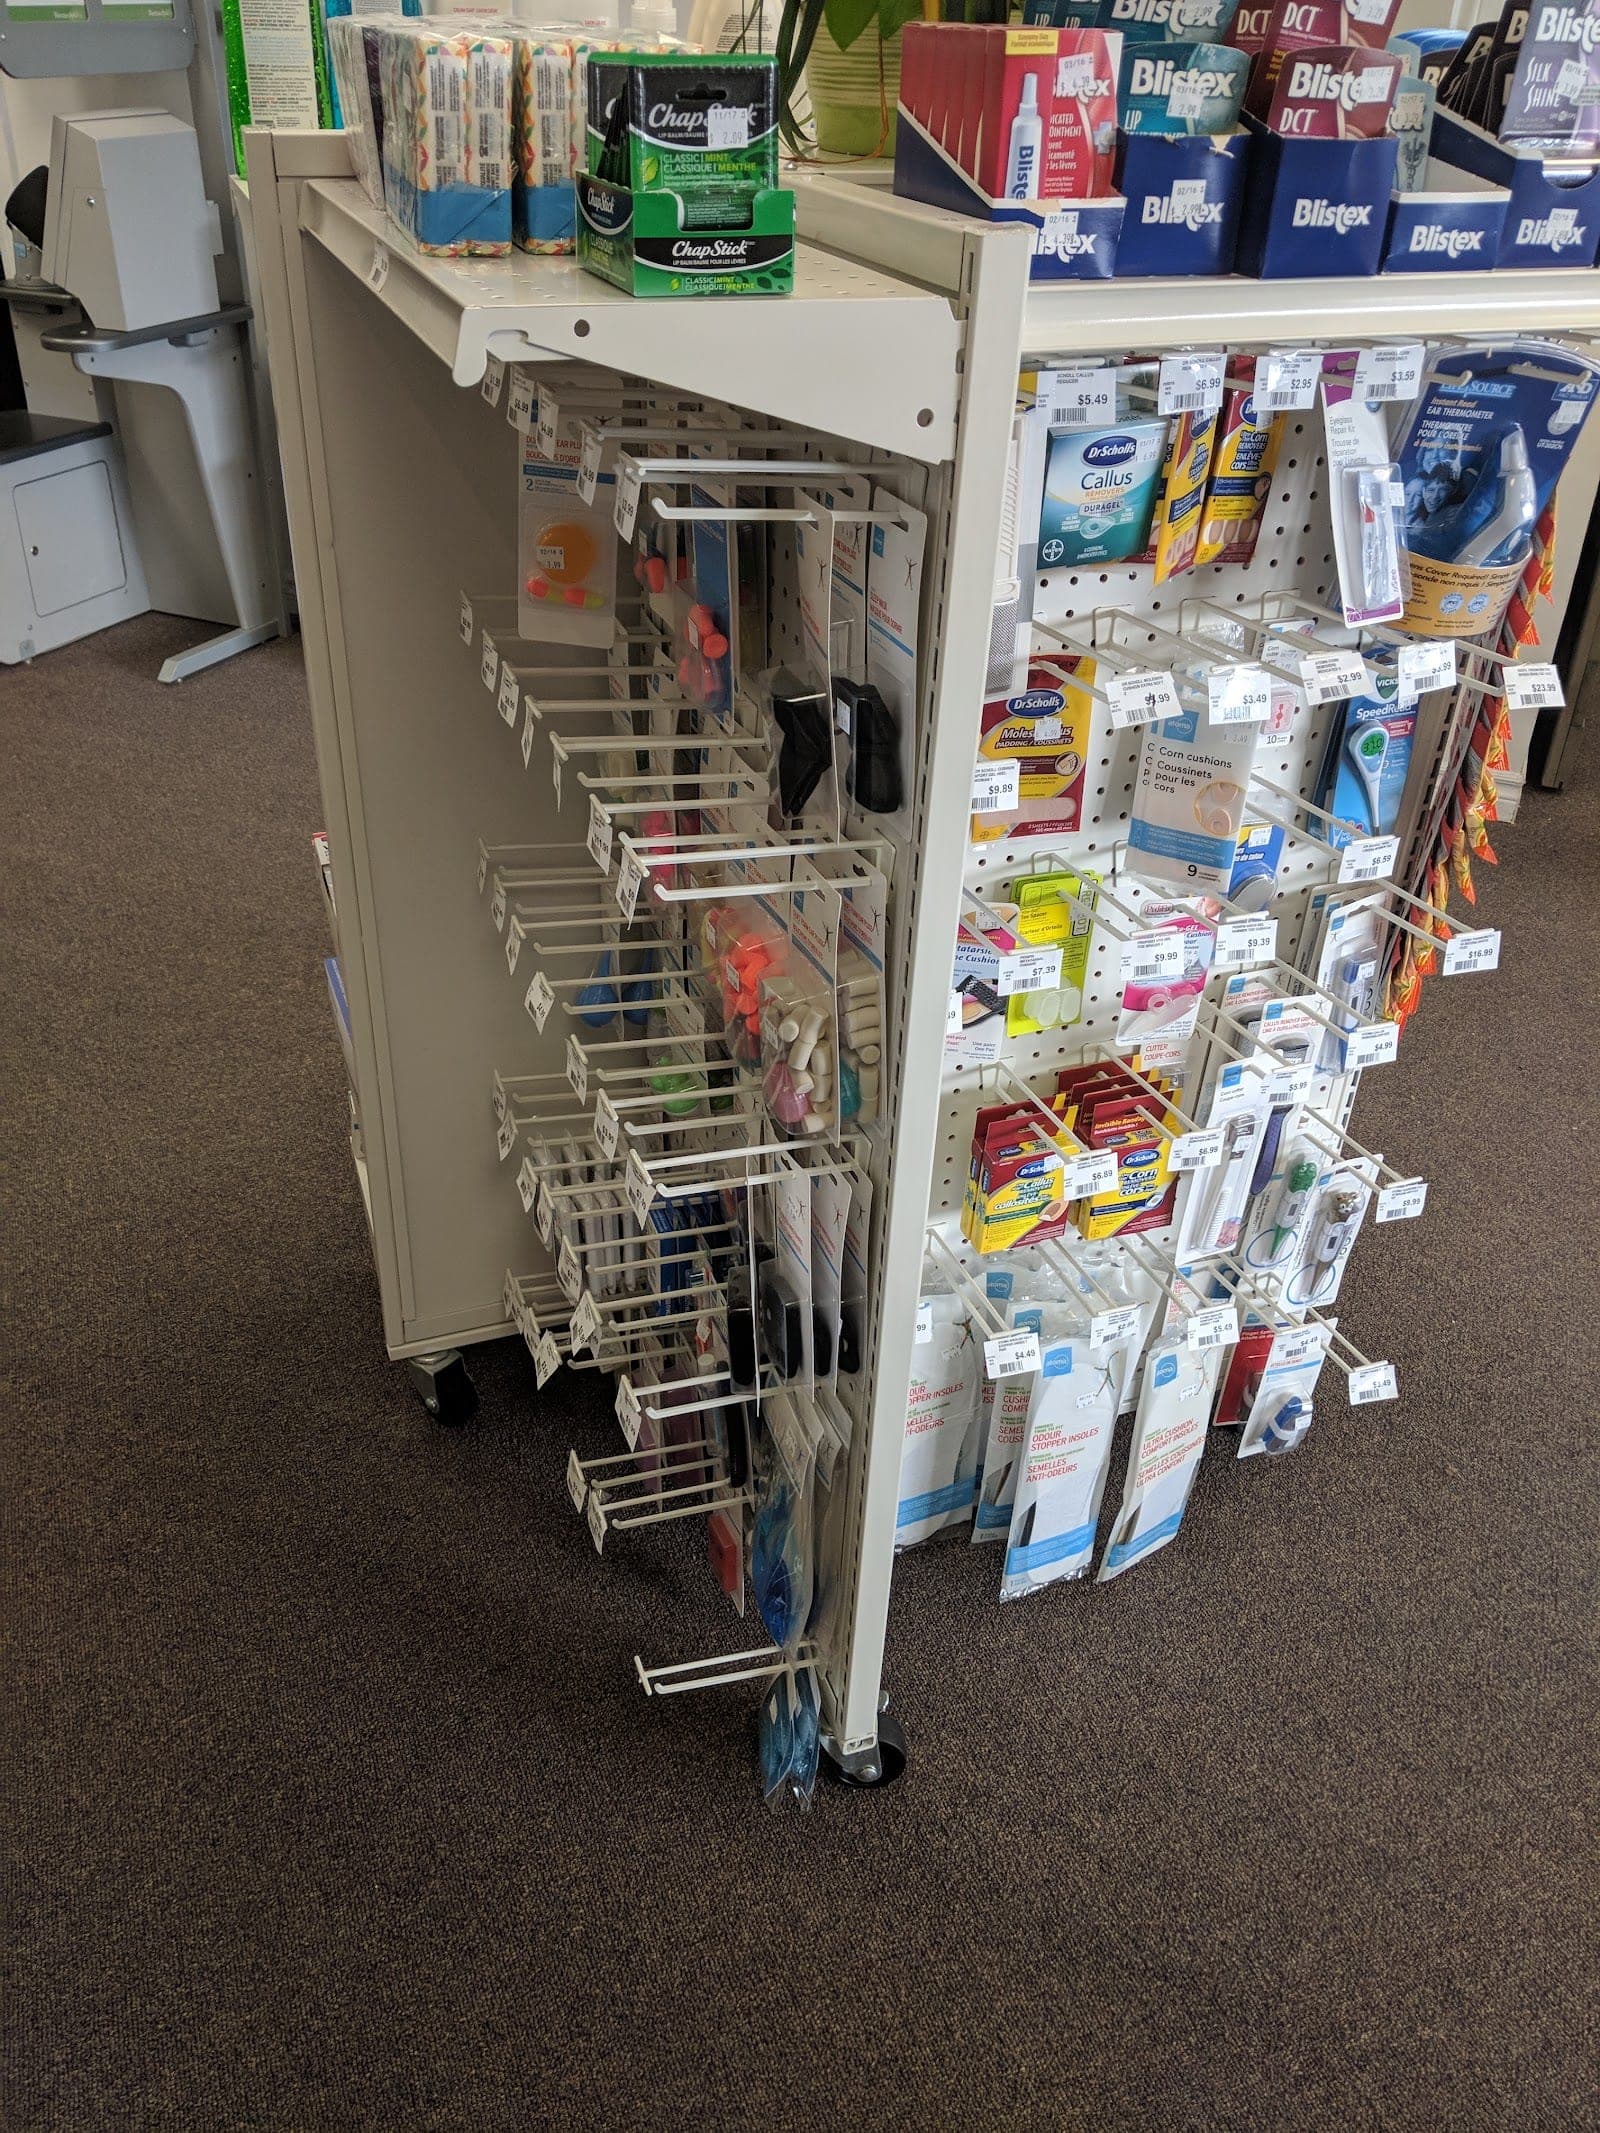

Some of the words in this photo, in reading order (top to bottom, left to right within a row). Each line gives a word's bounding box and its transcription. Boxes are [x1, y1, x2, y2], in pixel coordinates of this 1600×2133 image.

[1236, 9, 1272, 35] DCT
[1282, 2, 1321, 33] DCT
[1535, 7, 1600, 53] Bliste
[1288, 61, 1362, 111] Bliste
[649, 103, 758, 131] Chapk
[1124, 110, 1142, 130] LIP
[1279, 107, 1318, 133] DCT
[663, 153, 699, 163] CLASSIC
[705, 153, 729, 161] MINT
[663, 163, 713, 173] CLASSIQUE
[718, 162, 757, 171] MENTHE
[1012, 145, 1034, 199] Bliste
[1142, 196, 1224, 232] Blitex
[1292, 198, 1373, 235] Blistex
[1409, 224, 1485, 259] Blistex
[1515, 219, 1587, 253] Bliex
[672, 239, 748, 260] ChapStick
[685, 276, 713, 284] CLASSIC
[1391, 370, 1415, 383] $3.59
[1195, 377, 1221, 391] $6.99
[1291, 379, 1312, 390] $2.95
[1077, 393, 1108, 406] $5.49
[1426, 406, 1441, 415] EAR
[1442, 408, 1494, 420] THERMOMETER
[569, 440, 583, 450] PLU
[526, 478, 534, 491] 2
[1081, 470, 1133, 490] Callus
[1084, 501, 1121, 513] DURAGEL
[1425, 567, 1450, 577] Cover
[1337, 671, 1362, 684] $2.99
[1243, 694, 1267, 705] $3.49
[1002, 727, 1035, 739] Moles
[1267, 734, 1277, 744] 10
[1159, 746, 1184, 760] Corn
[1186, 751, 1232, 769] cushions
[1157, 760, 1212, 779] Coussinets
[1155, 772, 1180, 786] pour
[1181, 774, 1195, 787] les
[989, 783, 1013, 795] $9.89
[1154, 782, 1175, 794] cors
[1187, 864, 1197, 877] 9
[1248, 937, 1271, 948] $9.39
[1154, 952, 1178, 963] $9.99
[1032, 965, 1056, 977] $7.39
[1146, 1043, 1168, 1052] CUTTER
[1144, 1050, 1182, 1061] COUPE-CORS
[1129, 1168, 1158, 1180] Corn
[1015, 1349, 1036, 1361] $4.49
[909, 1385, 926, 1397] OUR
[933, 1382, 964, 1399] INSOLES
[1003, 1394, 1030, 1404] CUSHI
[1002, 1403, 1029, 1413] COMF
[999, 1425, 1025, 1434] SEMEL
[1164, 1418, 1194, 1438] CUSHION
[997, 1434, 1024, 1444] COUSS
[1031, 1438, 1067, 1452] STOPPER
[1068, 1426, 1099, 1444] INSOLES
[1032, 1430, 1063, 1443] ODOUR
[1027, 1458, 1067, 1474] SEMELLES
[1025, 1463, 1078, 1484] ANTI-ODEURS
